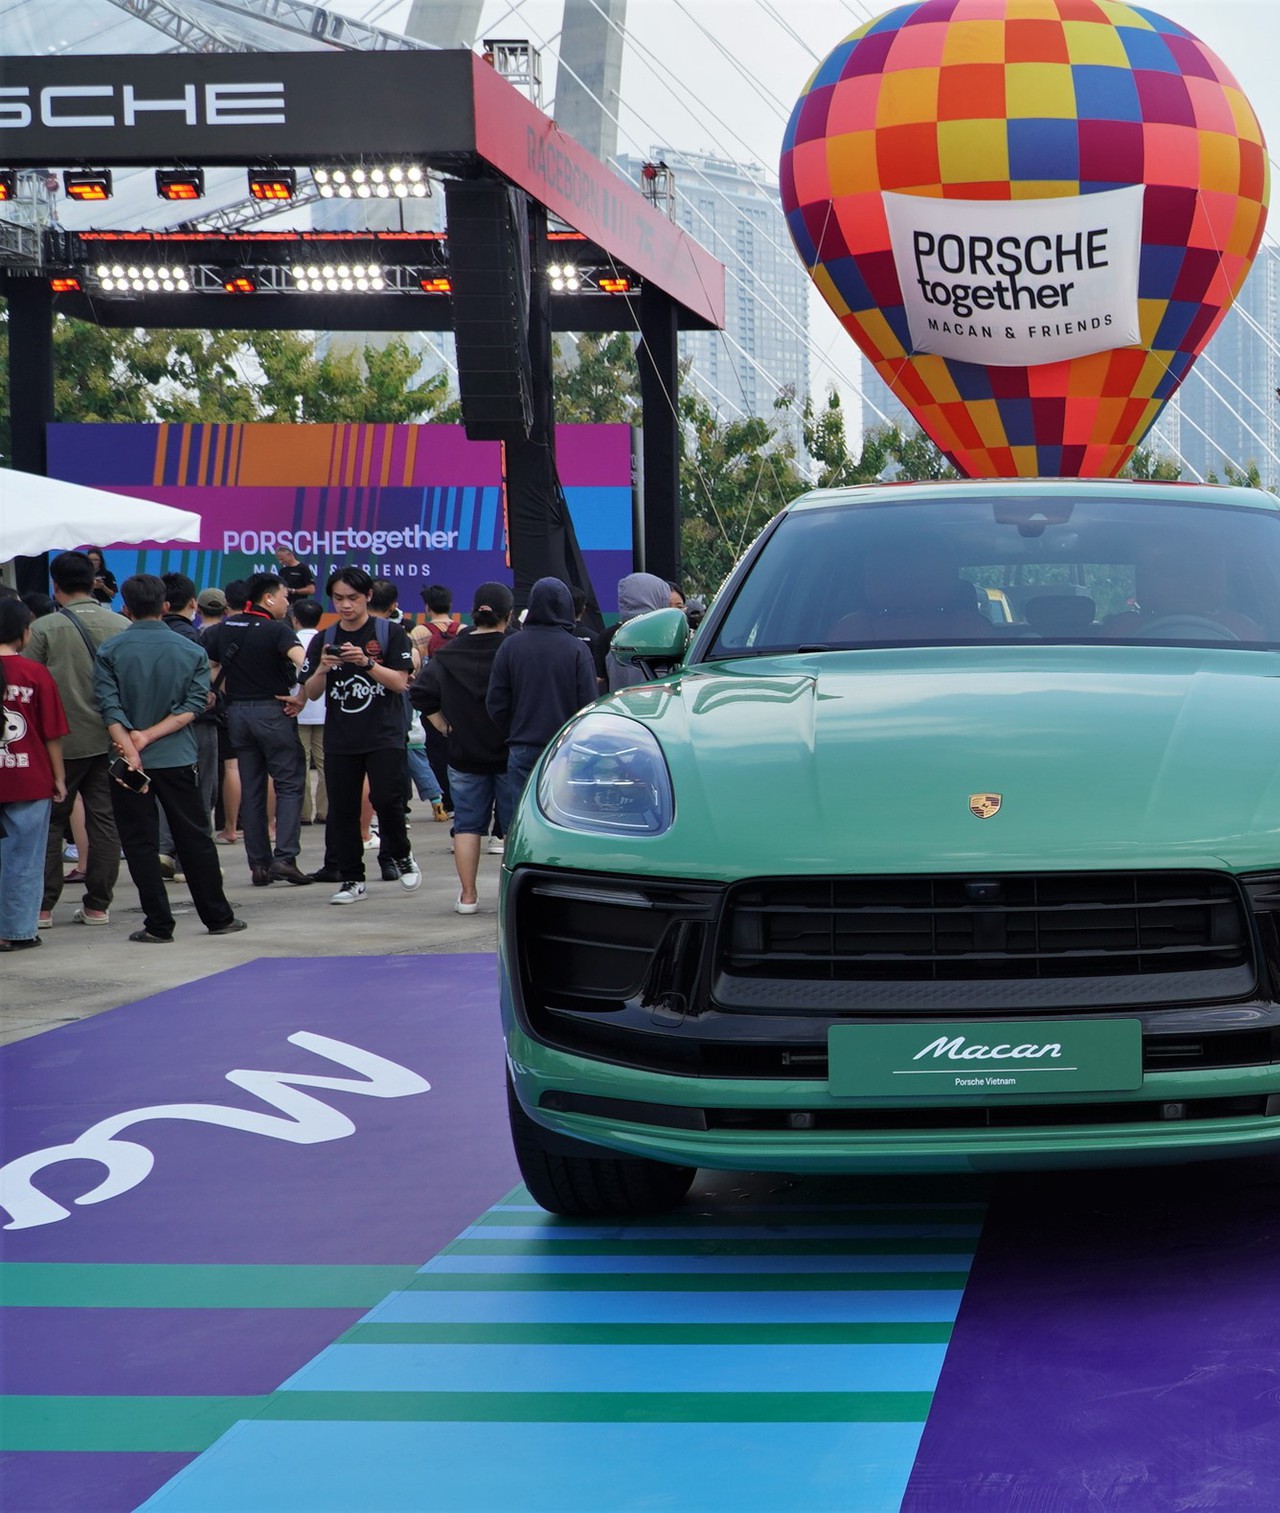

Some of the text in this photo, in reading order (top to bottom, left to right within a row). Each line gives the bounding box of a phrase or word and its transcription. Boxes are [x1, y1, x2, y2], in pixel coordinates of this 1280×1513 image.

[913, 228, 1109, 277] PORSCHE
[917, 276, 1075, 318] together
[928, 314, 1113, 339] MACAN & FRIENDS
[253, 563, 318, 577] MAN
[351, 563, 432, 577] RIENDS
[912, 1035, 1062, 1060] Macan
[955, 1076, 1016, 1086] Porsche Vietnam
